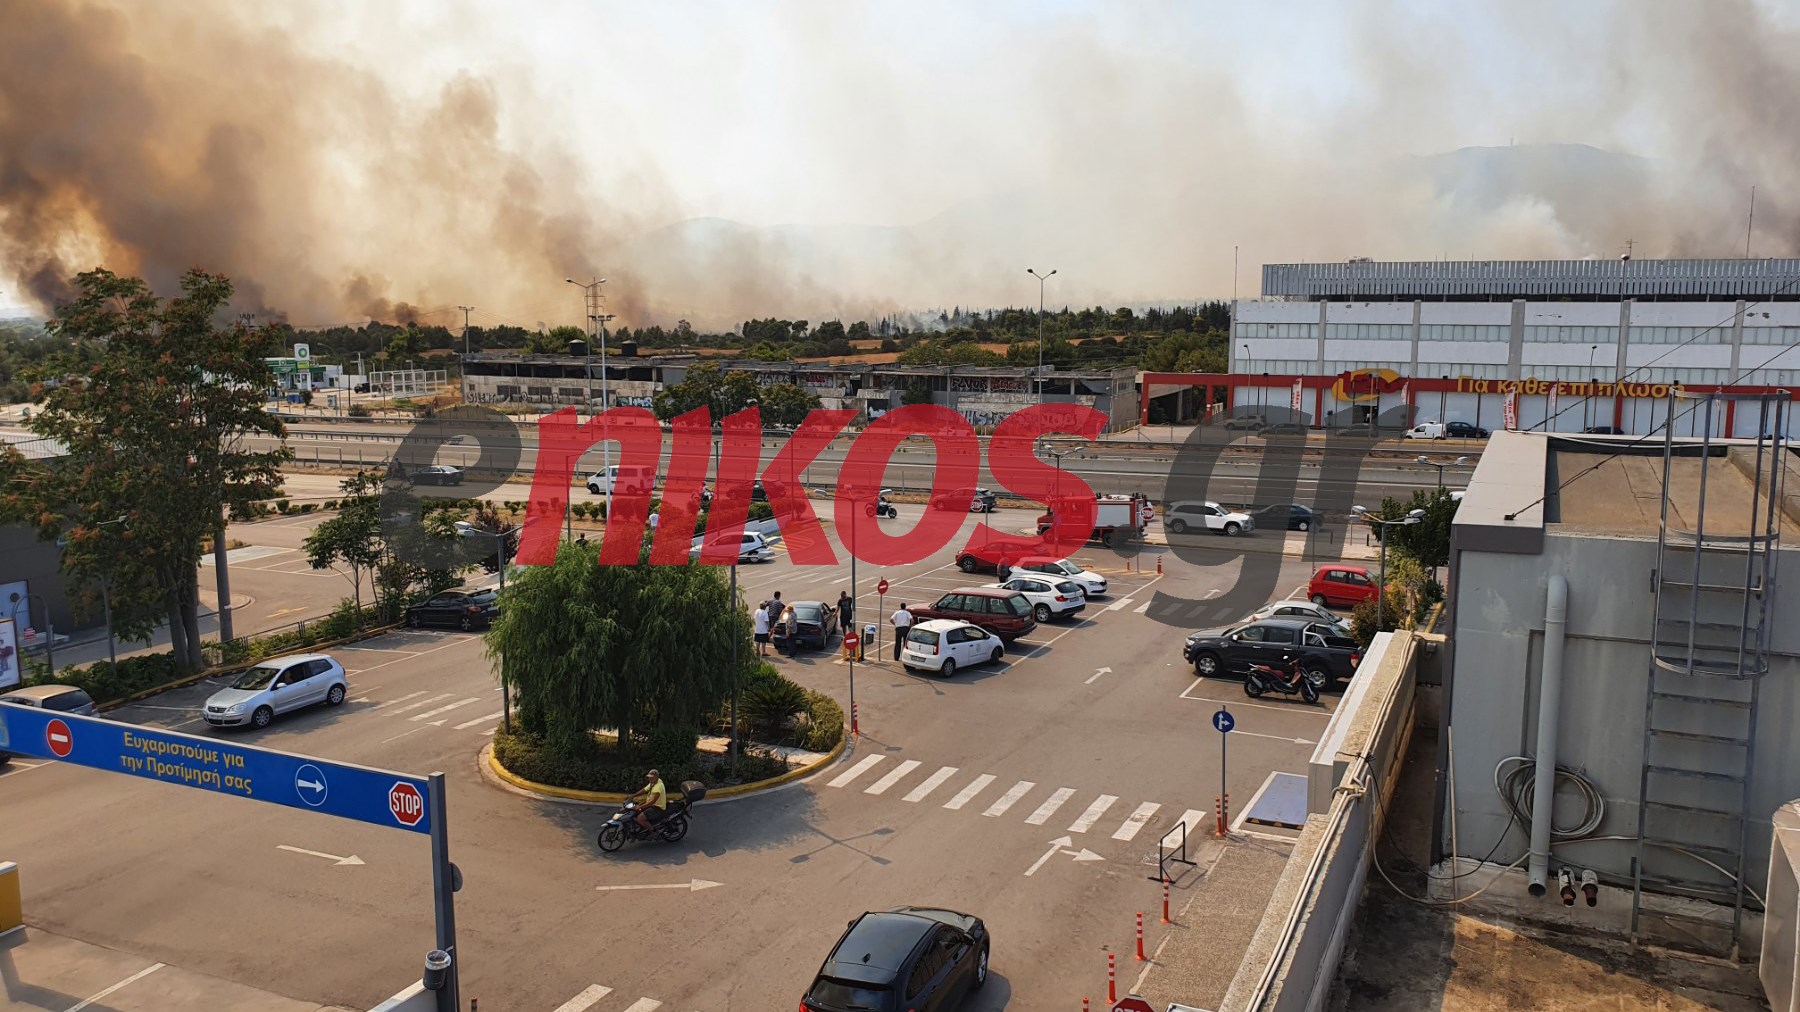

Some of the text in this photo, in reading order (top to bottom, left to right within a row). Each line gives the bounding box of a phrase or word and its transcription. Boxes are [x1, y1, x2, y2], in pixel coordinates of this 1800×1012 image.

[1457, 375, 1488, 394] Για
[123, 731, 245, 769] Ευχαριστούμε για
[120, 755, 253, 795] την Προτίμησή σας
[391, 791, 421, 815] STOP
